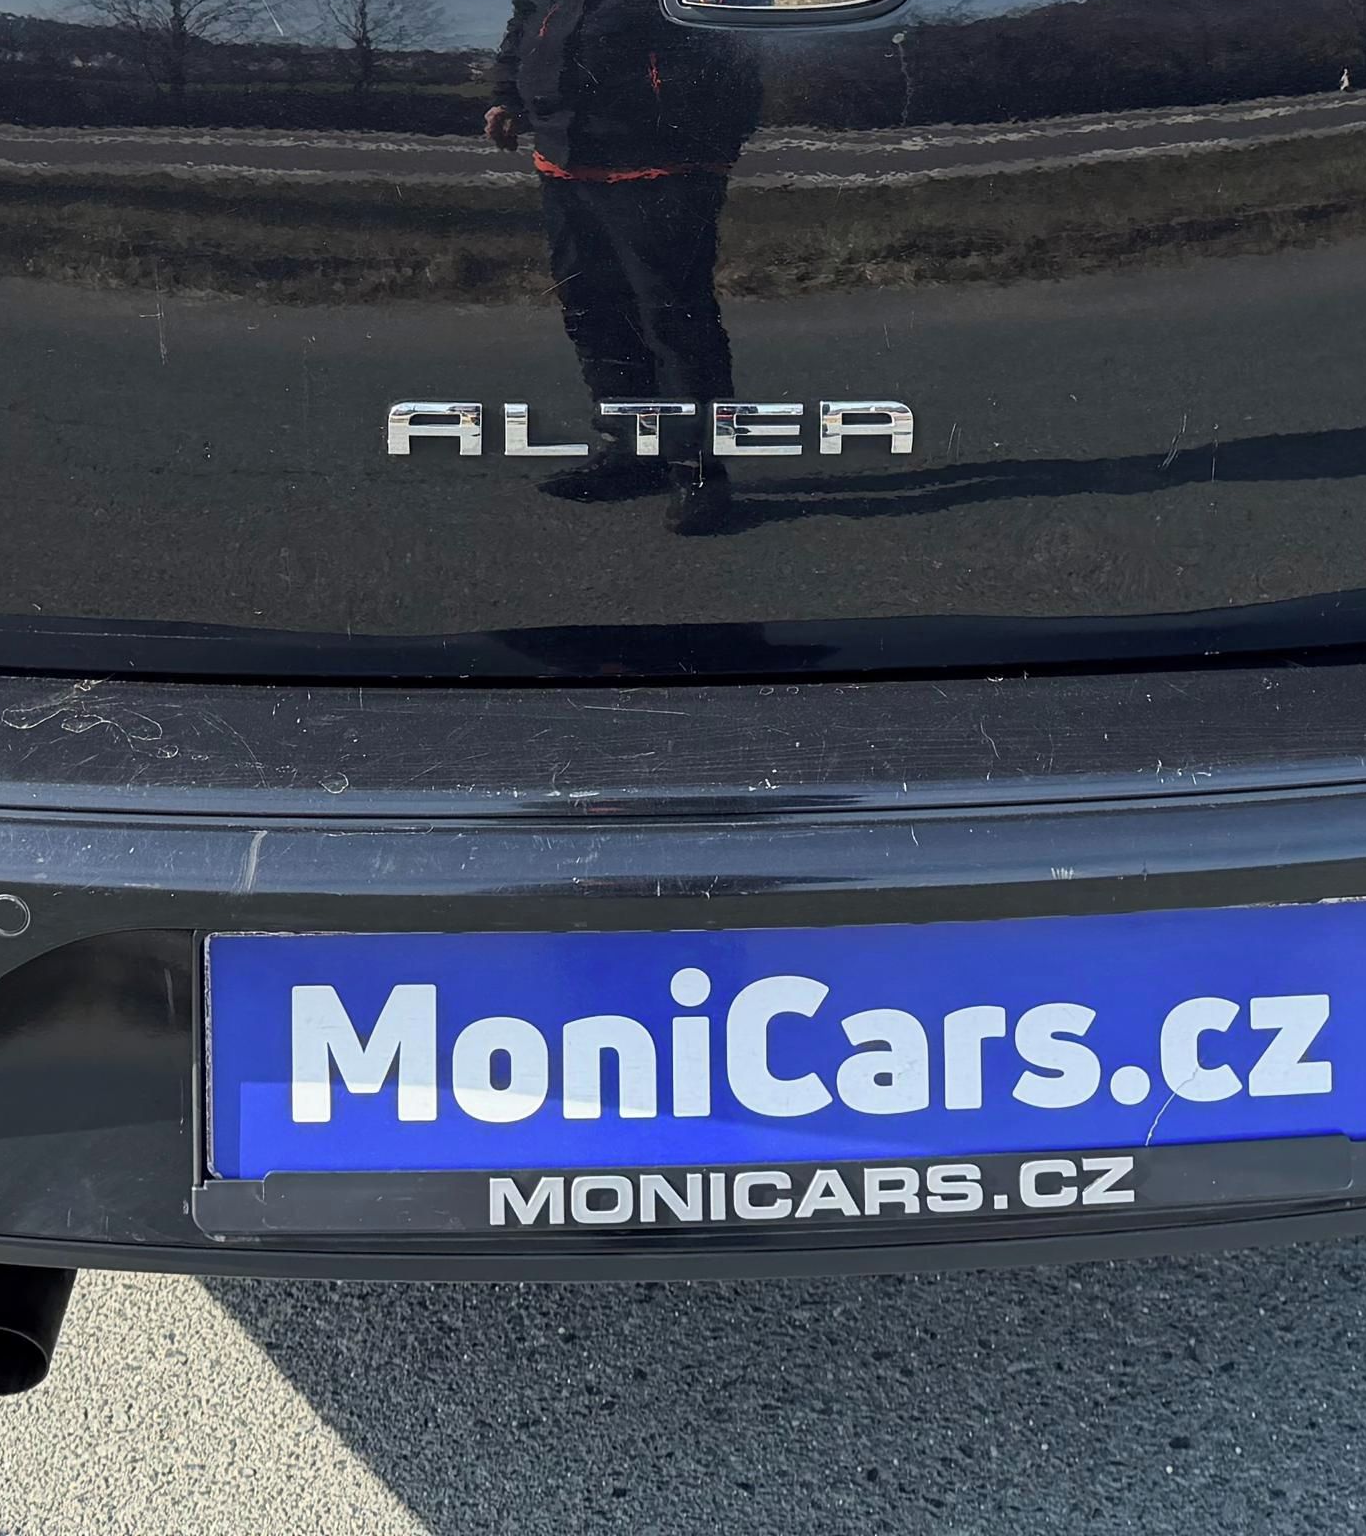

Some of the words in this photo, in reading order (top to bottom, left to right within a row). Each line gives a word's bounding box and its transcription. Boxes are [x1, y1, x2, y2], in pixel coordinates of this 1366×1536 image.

[387, 401, 915, 456] ALTEA
[290, 966, 1333, 1123] MoniCars.cz
[488, 1156, 1136, 1226] MONICARS.CZ
